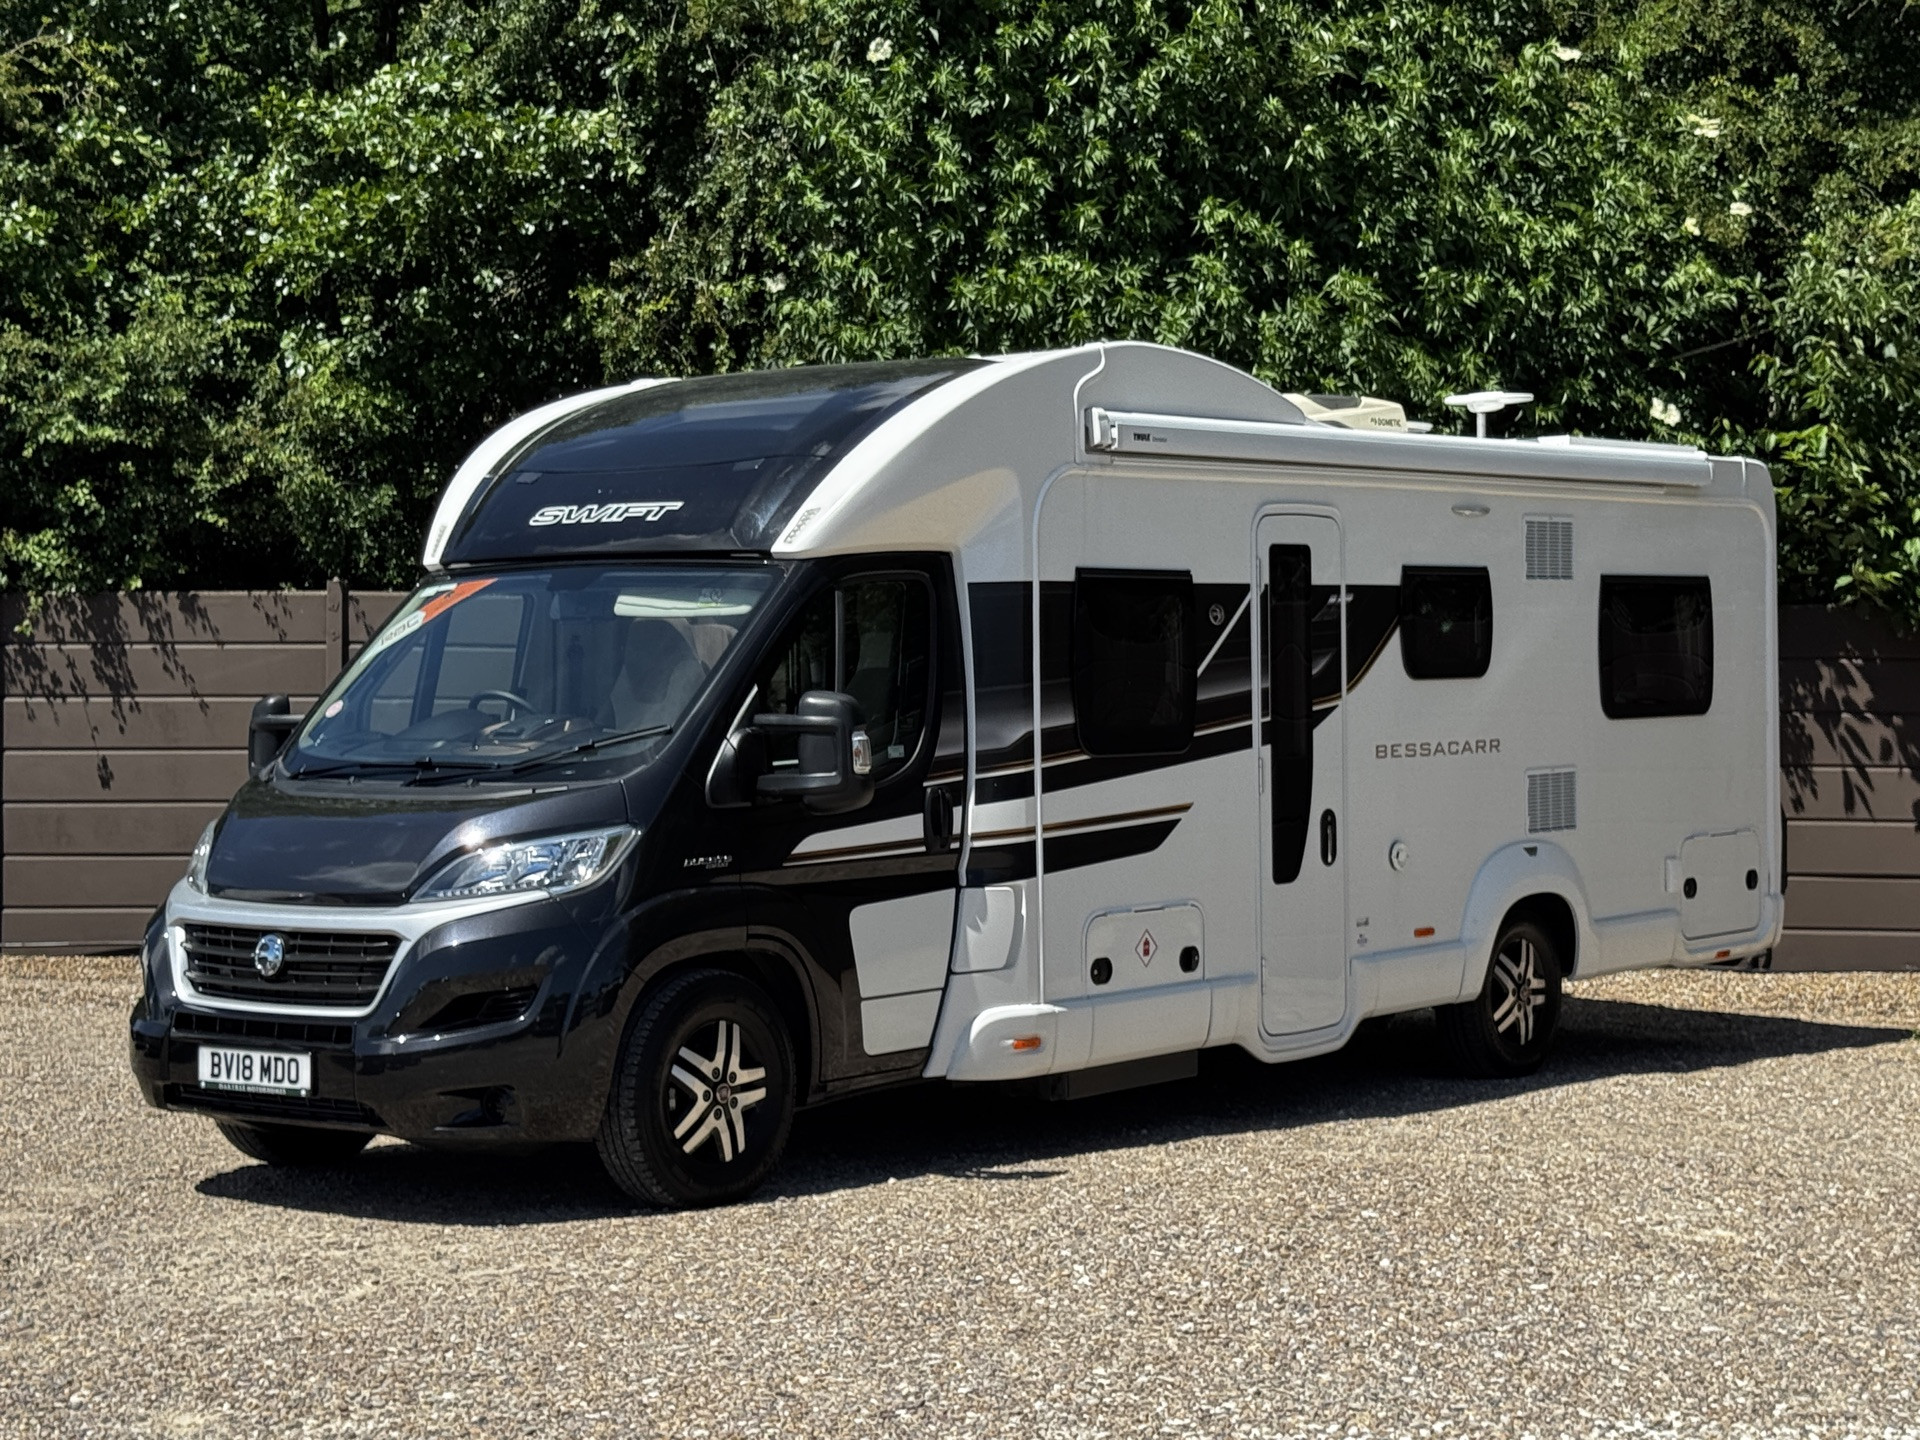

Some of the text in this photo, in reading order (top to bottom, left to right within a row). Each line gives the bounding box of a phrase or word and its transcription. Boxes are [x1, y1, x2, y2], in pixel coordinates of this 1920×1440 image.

[529, 501, 685, 526] SWIFT
[1375, 738, 1501, 759] BESSACARR
[210, 1051, 300, 1084] BV18 MDO
